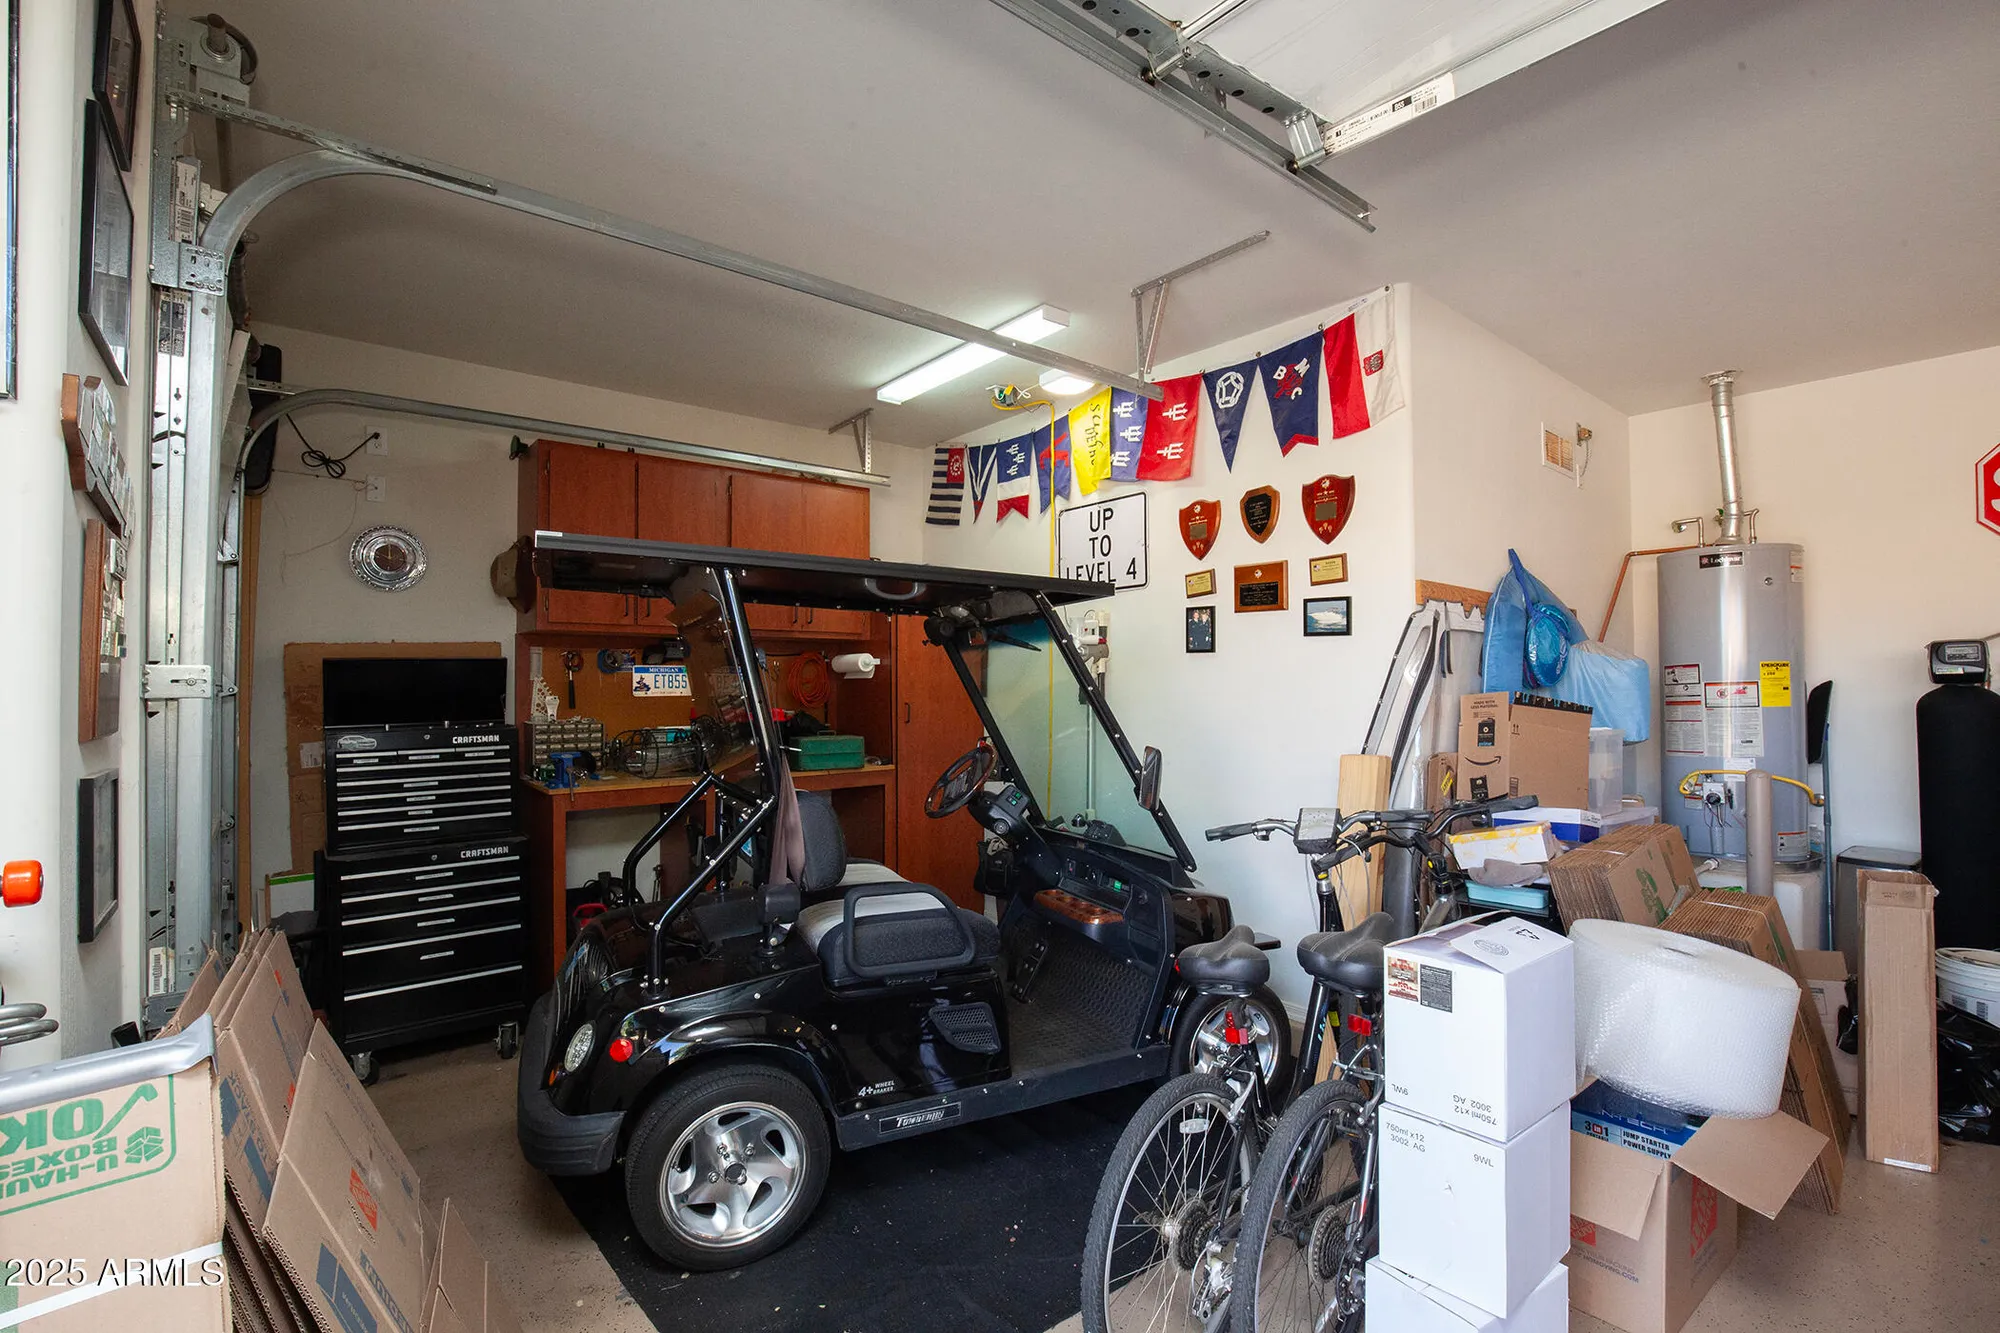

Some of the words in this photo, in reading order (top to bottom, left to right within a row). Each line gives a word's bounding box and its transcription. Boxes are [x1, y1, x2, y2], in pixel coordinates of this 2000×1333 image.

[1089, 507, 1114, 532] UP
[1088, 534, 1112, 559] TO
[1066, 561, 1116, 583] LEVEL
[1126, 557, 1137, 580] 4
[452, 734, 500, 744] CRAFTSMAN
[460, 846, 509, 858] CRAFTSMAN
[874, 1080, 895, 1089] WHEEL
[1452, 1094, 1466, 1105] AG
[1470, 1099, 1492, 1113] 3002
[1390, 1133, 1409, 1147] 3002
[1413, 1142, 1426, 1153] AG
[1622, 1130, 1640, 1141] JUMP
[1641, 1136, 1670, 1151] STARTER
[1623, 1139, 1646, 1152] POWER
[1647, 1146, 1671, 1159] SUPPLY
[0, 1154, 118, 1199] U-HAU
